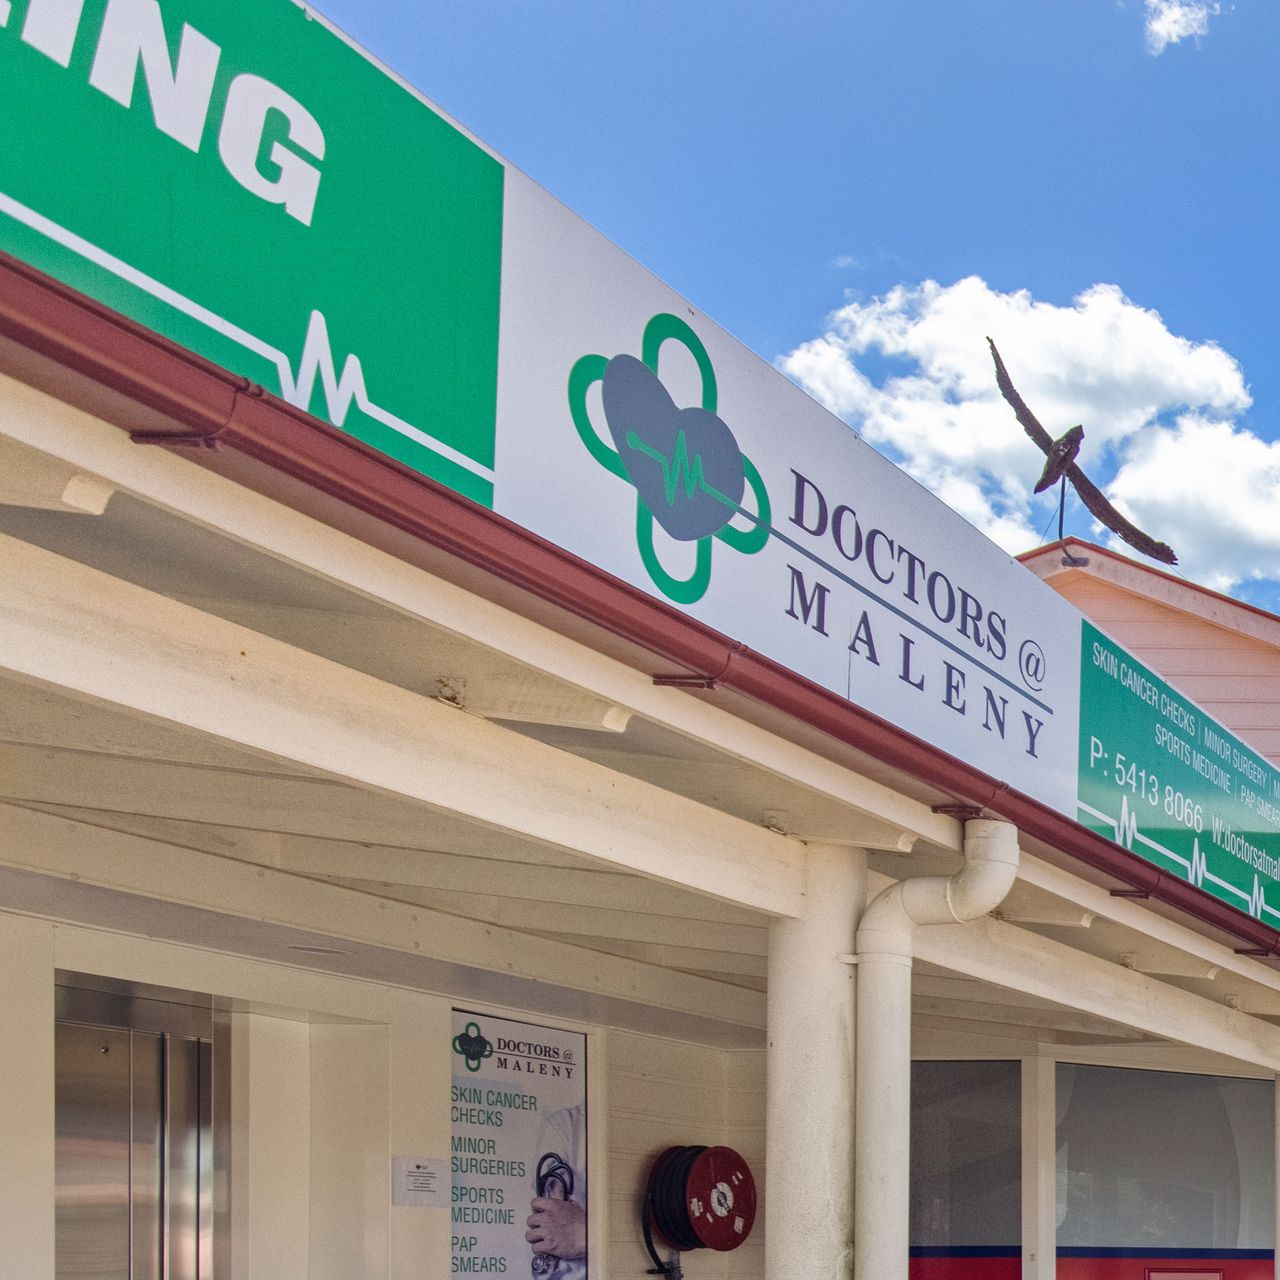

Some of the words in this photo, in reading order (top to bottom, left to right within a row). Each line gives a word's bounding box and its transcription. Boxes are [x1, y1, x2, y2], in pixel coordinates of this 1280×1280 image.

[788, 468, 1006, 660] DOCTORS
[1019, 639, 1046, 692] @
[785, 563, 1044, 758] MALENY
[1093, 642, 1118, 679] SKIN
[1120, 663, 1159, 710] CANCER
[1161, 694, 1195, 736] CHECKS
[1205, 727, 1231, 763] MINOR
[1232, 749, 1267, 788] SURGERY
[1155, 723, 1190, 765] SPORTS
[1193, 750, 1230, 794] MEDICINE
[1241, 785, 1255, 808] PAP
[1090, 735, 1108, 776] P:
[1115, 752, 1158, 806] 5413
[1164, 785, 1202, 833] 8066
[497, 1038, 560, 1059] DOCTORS
[562, 1050, 574, 1063] @
[497, 1057, 573, 1079] MALENY
[451, 1085, 482, 1105] SKIN
[486, 1090, 537, 1111] CANCER
[451, 1105, 503, 1127] CHECKS
[451, 1136, 496, 1155] MINOR
[451, 1156, 526, 1177] SURGERIES
[451, 1186, 504, 1204] SPORTS
[451, 1207, 515, 1225] MEDICINE
[451, 1236, 477, 1252] PAP
[451, 1256, 507, 1273] SMEARS
